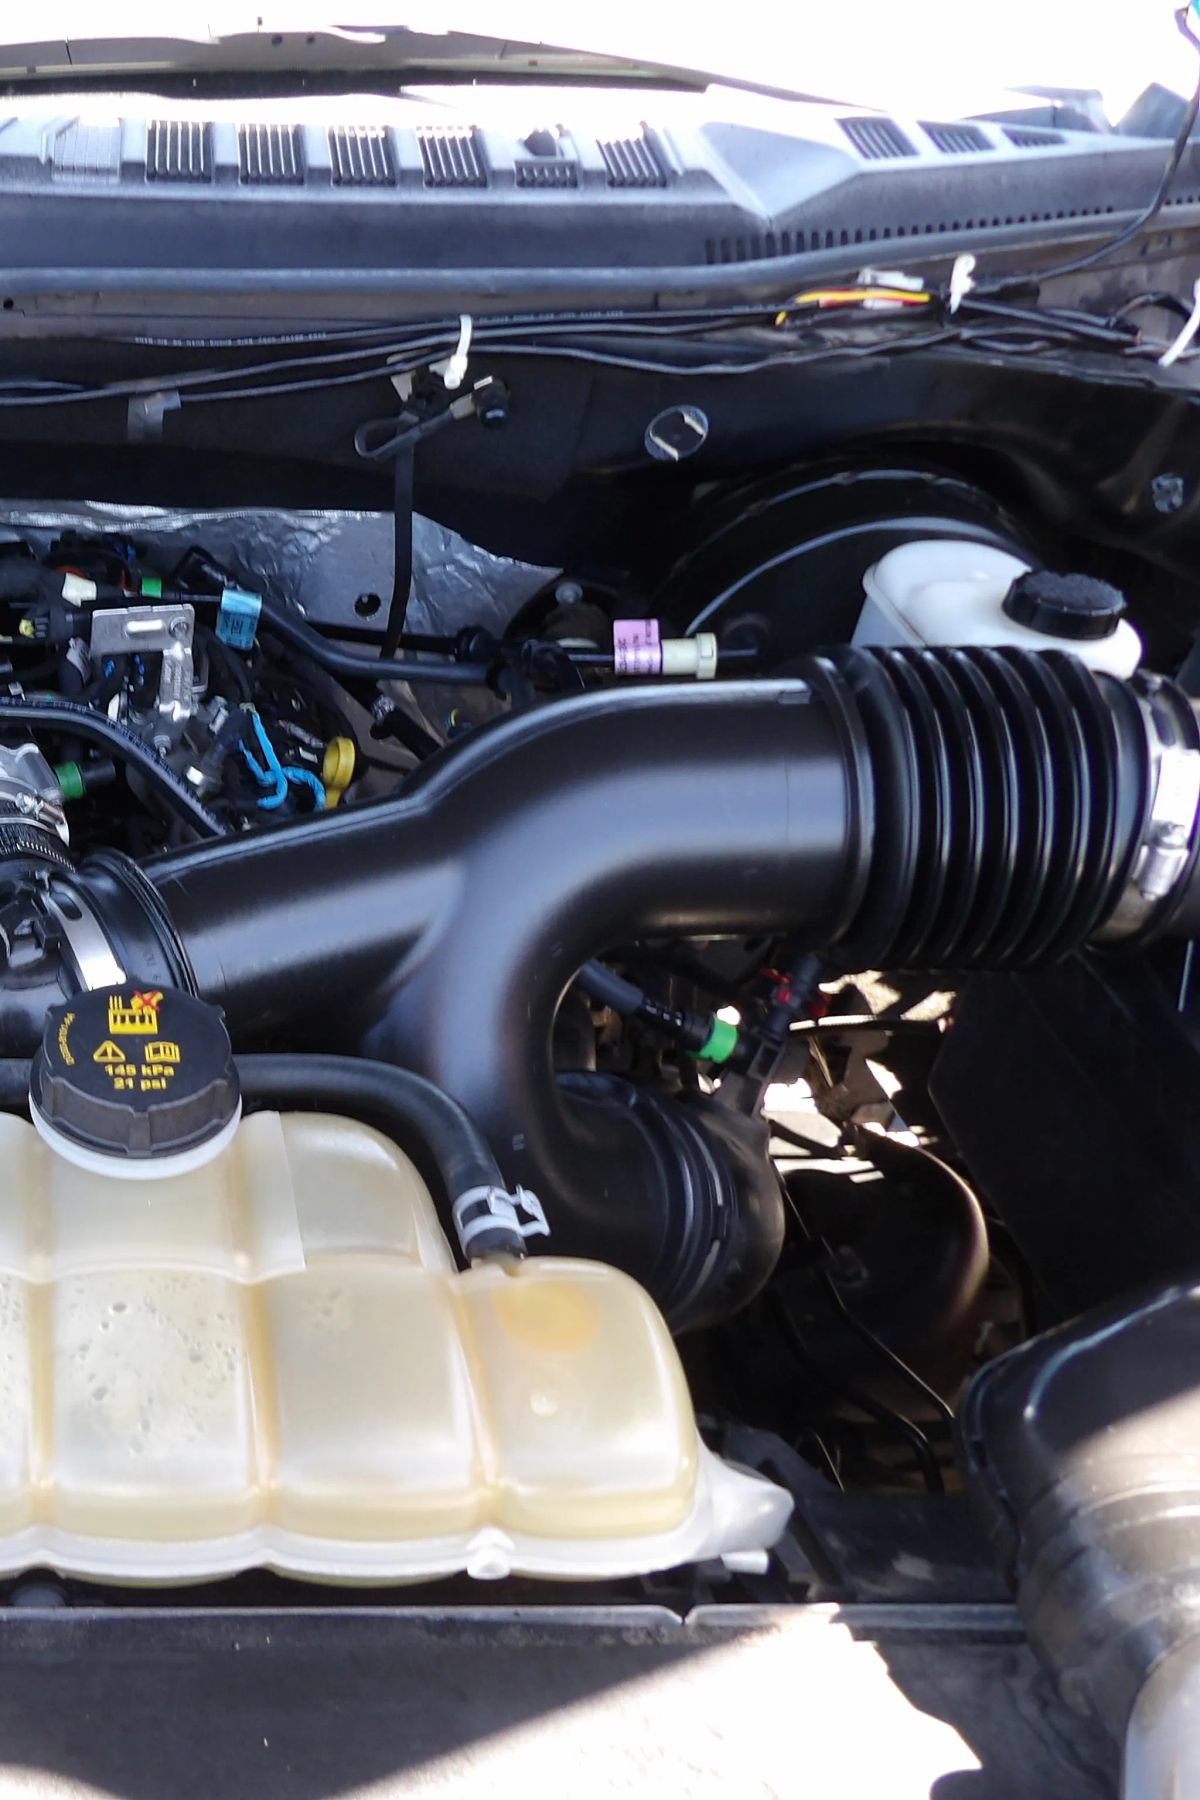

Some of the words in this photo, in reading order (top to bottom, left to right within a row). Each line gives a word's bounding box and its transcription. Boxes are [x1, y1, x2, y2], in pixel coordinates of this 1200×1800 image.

[105, 1064, 137, 1077] 145
[141, 1064, 175, 1077] kPa
[141, 1077, 167, 1092] psi
